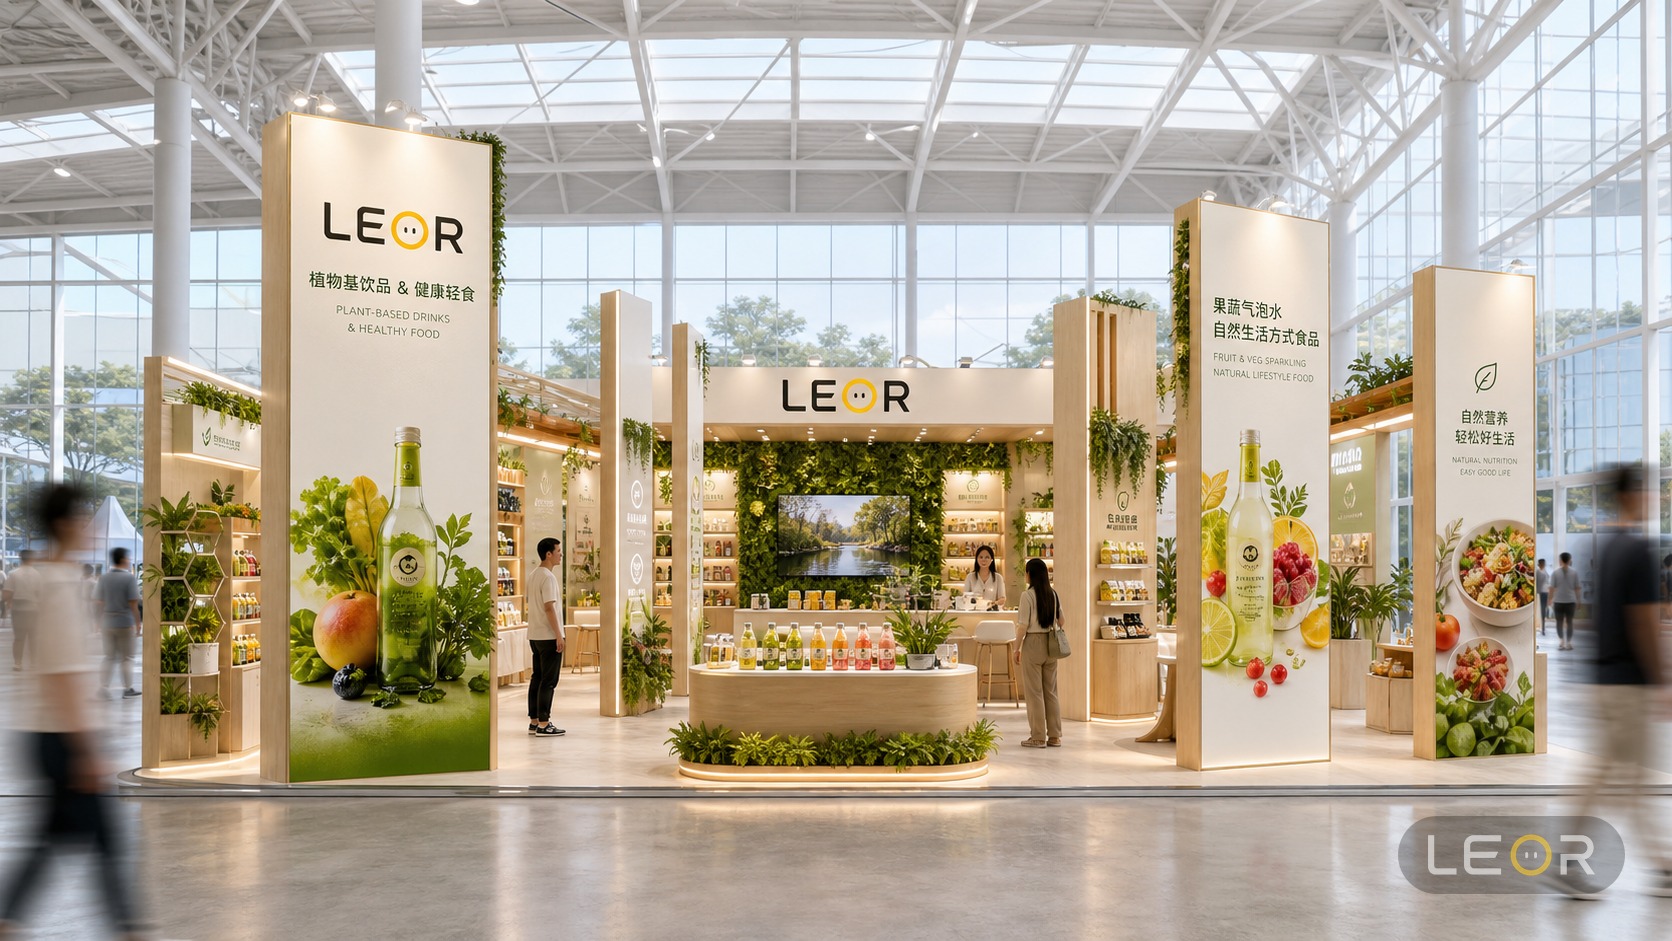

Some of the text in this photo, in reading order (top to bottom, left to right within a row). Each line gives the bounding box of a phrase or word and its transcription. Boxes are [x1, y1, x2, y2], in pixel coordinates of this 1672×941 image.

[324, 202, 463, 254] LEOR
[309, 271, 475, 302] 植物基饮品 & 健康轻食
[336, 304, 451, 324] PLANT-BASED DRINKS
[1213, 296, 1282, 320] 果蔬气泡水
[347, 323, 440, 339] & HEALTHY FOOD
[1214, 320, 1319, 347] 自然生活方式食品
[1213, 352, 1306, 367] FRUIT & VEG SPARKLING
[1213, 368, 1314, 383] NATURAL LIFESTYLE FOOD
[782, 378, 910, 414] LEOR
[1461, 409, 1508, 426] 自然营养
[1455, 429, 1515, 446] 轻松好生活
[1452, 456, 1518, 465] NATURAL NUTRITION
[1460, 468, 1476, 476] EASY
